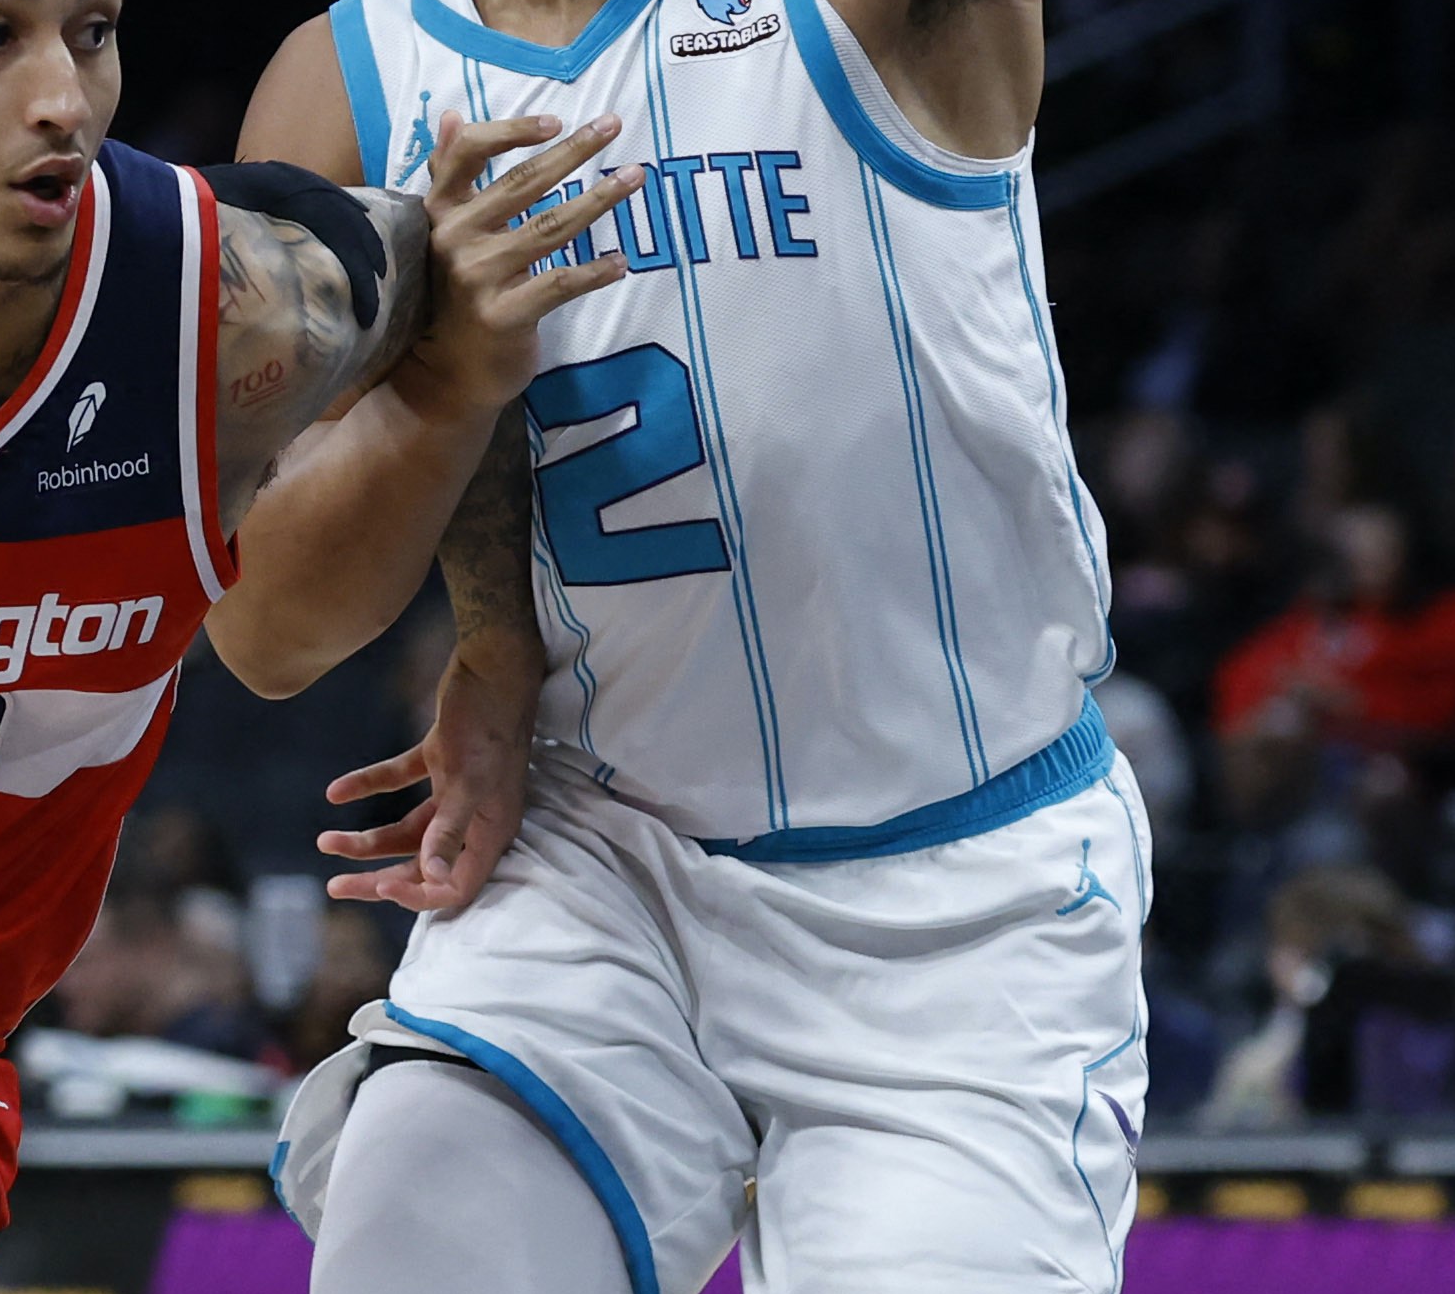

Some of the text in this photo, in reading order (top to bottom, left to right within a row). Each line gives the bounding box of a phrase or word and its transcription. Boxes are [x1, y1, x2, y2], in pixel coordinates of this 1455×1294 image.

[671, 14, 781, 57] FEASTABLES
[230, 359, 285, 405] 100
[37, 453, 150, 493] Robinhood
[524, 342, 732, 587] 2
